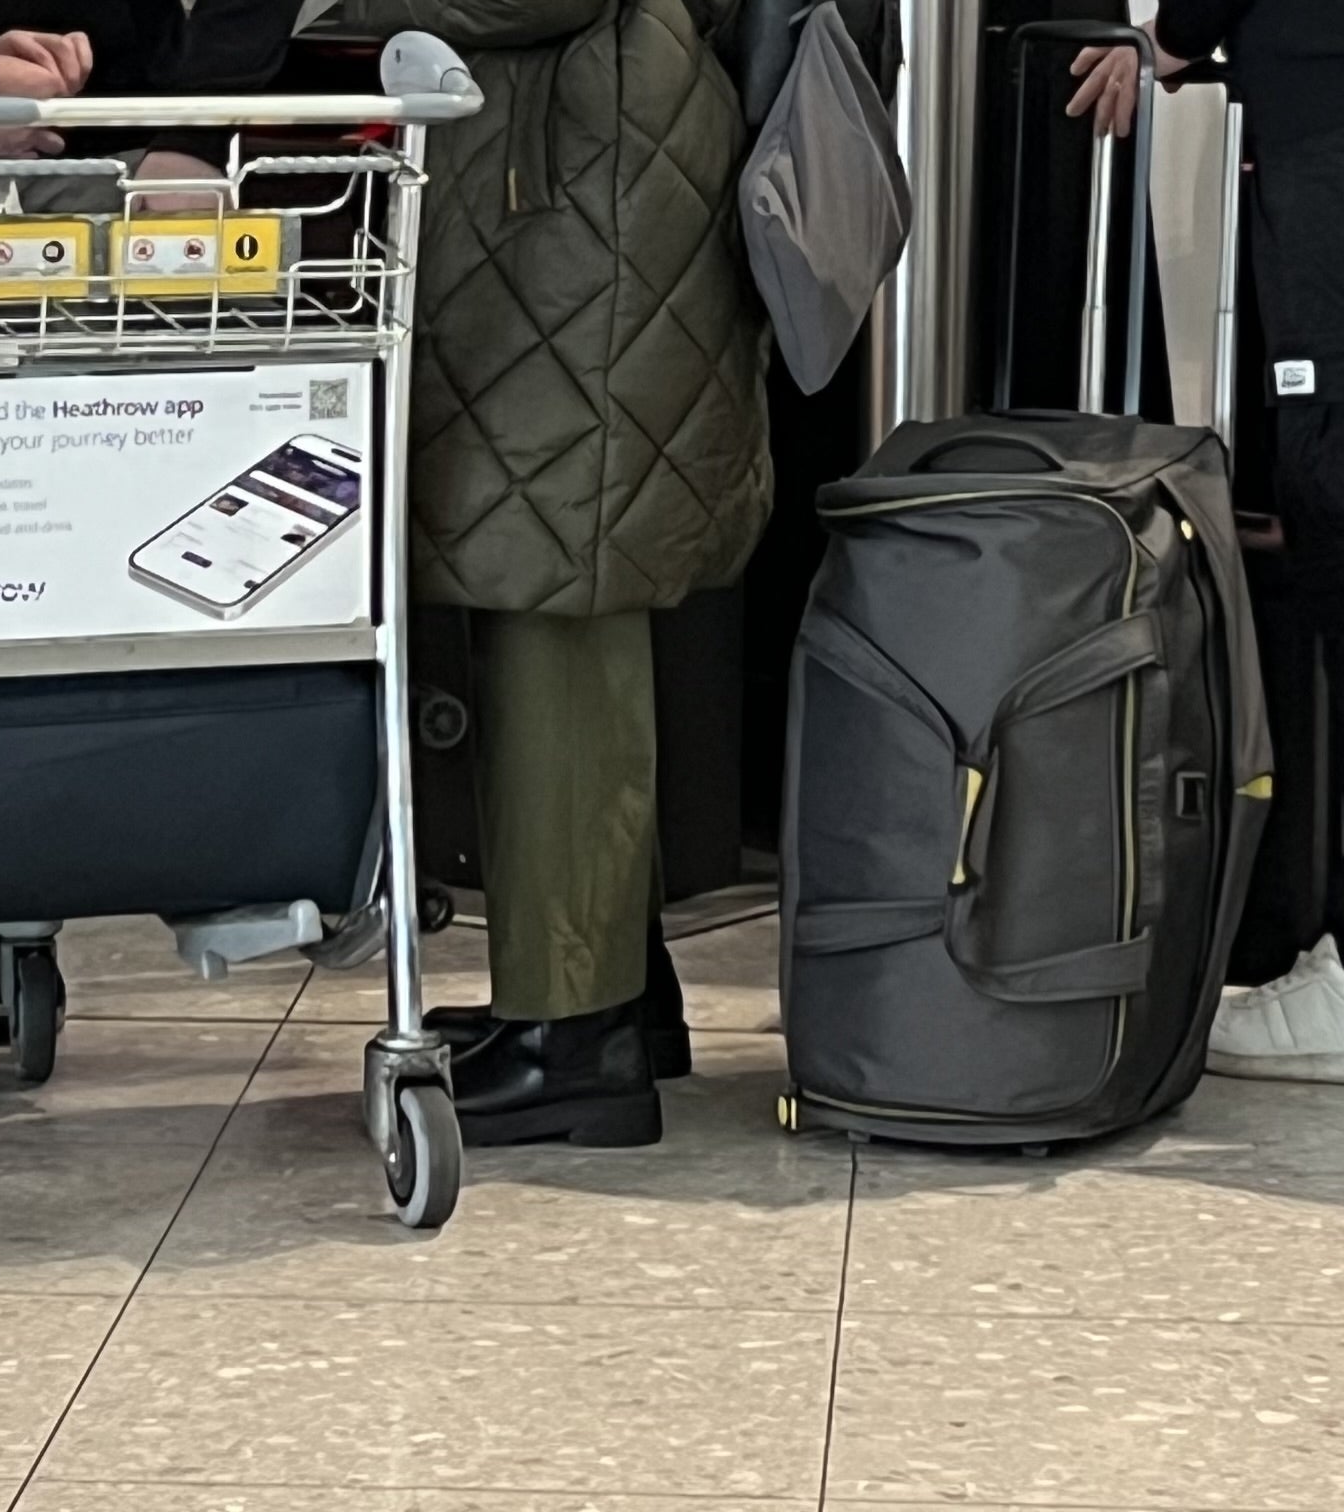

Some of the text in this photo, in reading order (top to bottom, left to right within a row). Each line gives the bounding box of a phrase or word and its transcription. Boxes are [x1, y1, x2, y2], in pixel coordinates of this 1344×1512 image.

[15, 401, 46, 420] the
[53, 398, 158, 419] Heathrow
[164, 399, 204, 419] app
[0, 435, 43, 455] your
[51, 430, 127, 453] journey
[134, 427, 194, 445] better
